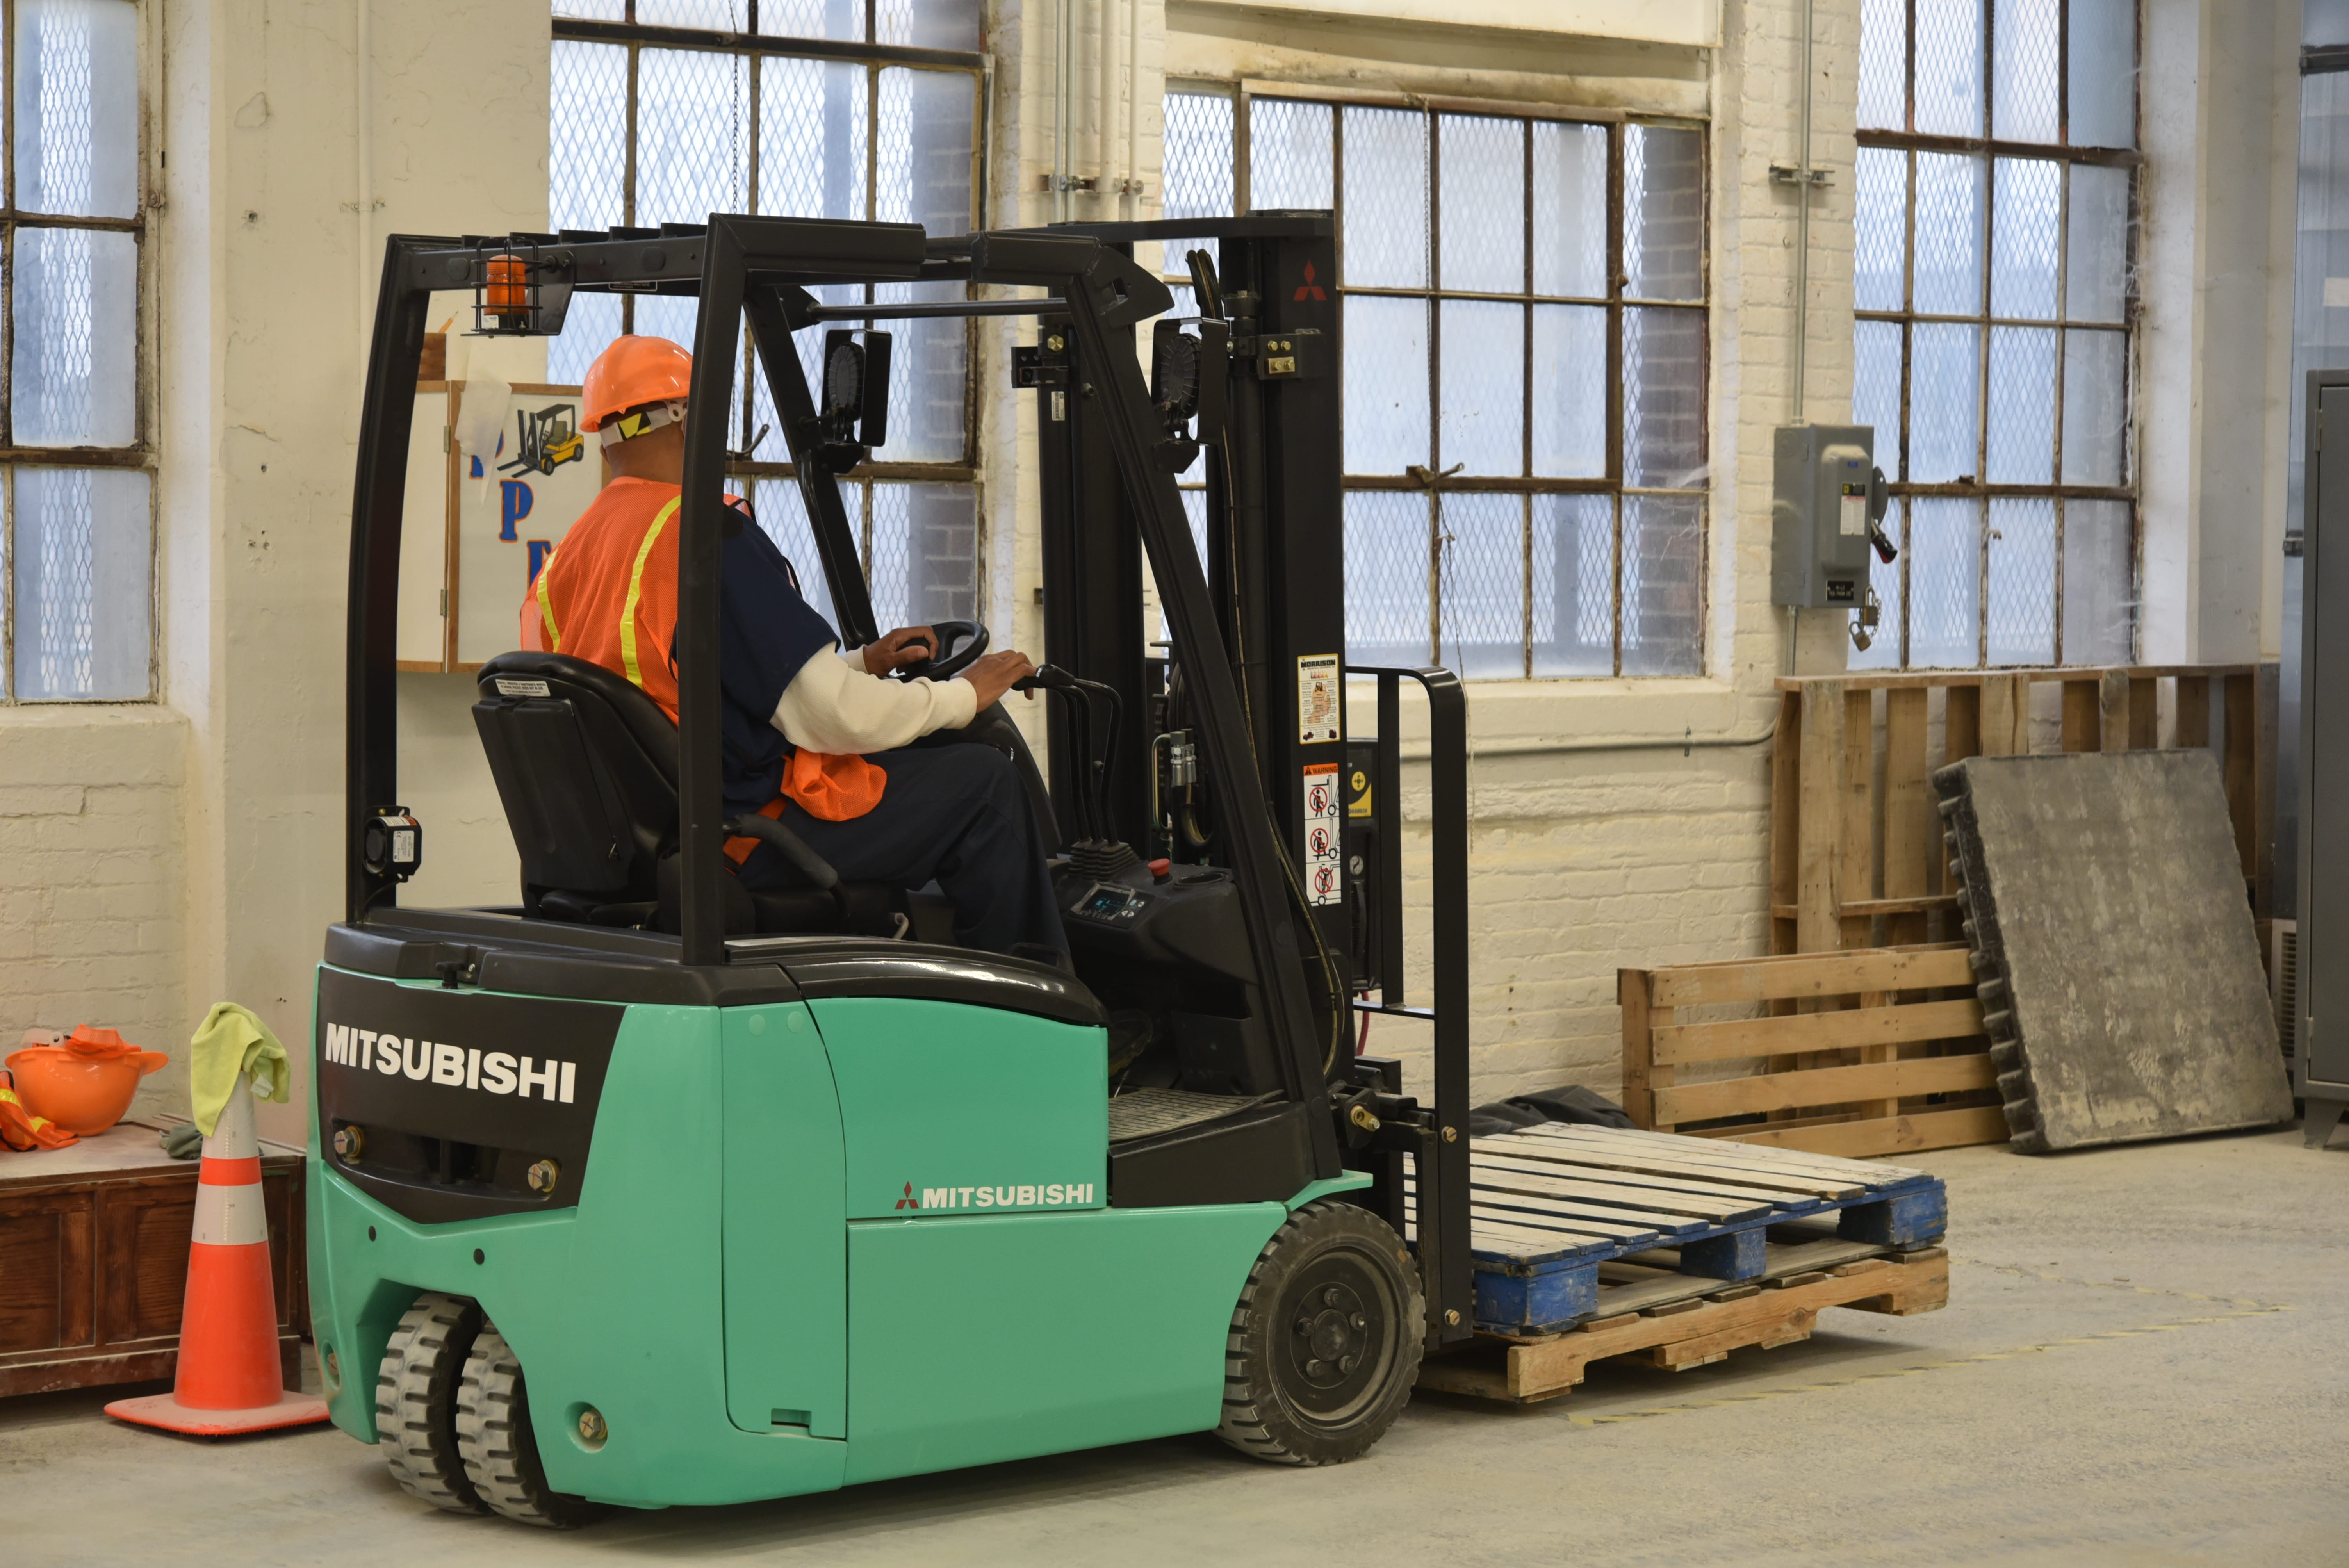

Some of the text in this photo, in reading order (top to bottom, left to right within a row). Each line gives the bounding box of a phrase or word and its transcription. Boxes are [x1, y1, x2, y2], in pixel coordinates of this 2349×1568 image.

[1301, 659, 1335, 668] MORRISON
[1313, 766, 1337, 774] WARNING
[325, 1023, 576, 1104] MITSUBISHI
[923, 1183, 1093, 1209] MITSUBISHI
